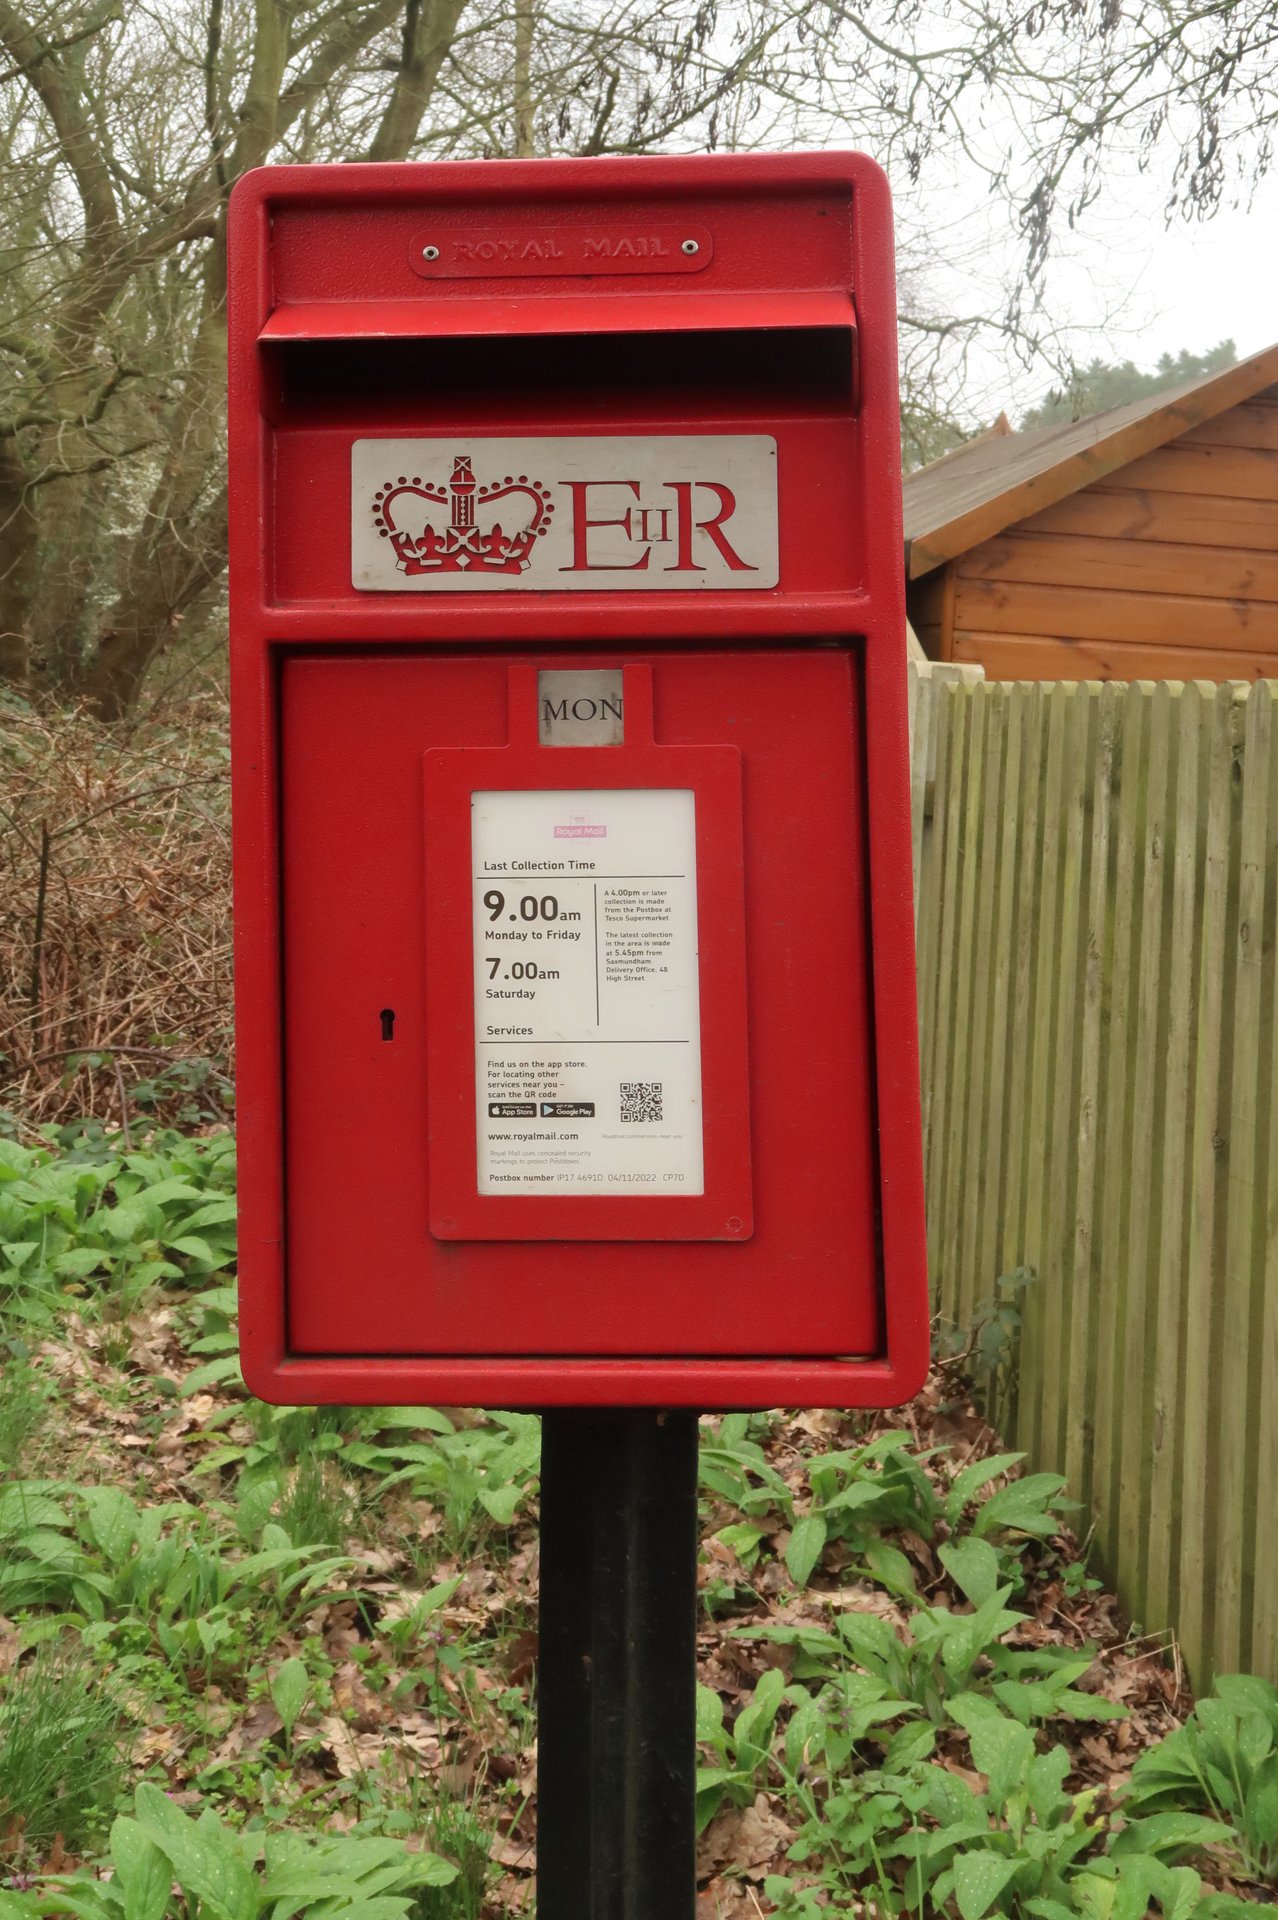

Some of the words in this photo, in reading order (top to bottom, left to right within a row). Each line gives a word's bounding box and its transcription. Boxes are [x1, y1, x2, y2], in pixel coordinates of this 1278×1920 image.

[452, 239, 564, 261] ROYAL
[583, 237, 669, 258] MAIL
[541, 698, 624, 721] MON
[556, 827, 581, 837] Royal
[584, 827, 604, 836] Mail
[484, 861, 507, 871] Last
[511, 860, 565, 871] Collection
[568, 860, 596, 870] Time
[611, 889, 640, 898] 4.00pm
[483, 890, 581, 922] 9.00am
[485, 930, 528, 942] Monday
[531, 931, 543, 940] to
[547, 930, 581, 941] Friday
[615, 949, 644, 957] 5.45pm
[485, 957, 560, 980] 7.00am
[486, 988, 536, 1000] Saturday
[486, 1025, 534, 1036] Services
[487, 1060, 504, 1068] Find
[503, 1070, 535, 1079] locating
[543, 1082, 558, 1090] you
[524, 1091, 536, 1099] QR
[556, 1108, 579, 1116] Google
[580, 1108, 592, 1116] Play
[488, 1132, 579, 1142] www.royalmail.com
[489, 1174, 521, 1182] Postbox
[523, 1174, 555, 1182] number
[557, 1173, 575, 1181] IP17
[607, 1173, 657, 1182] 04/11/2022
